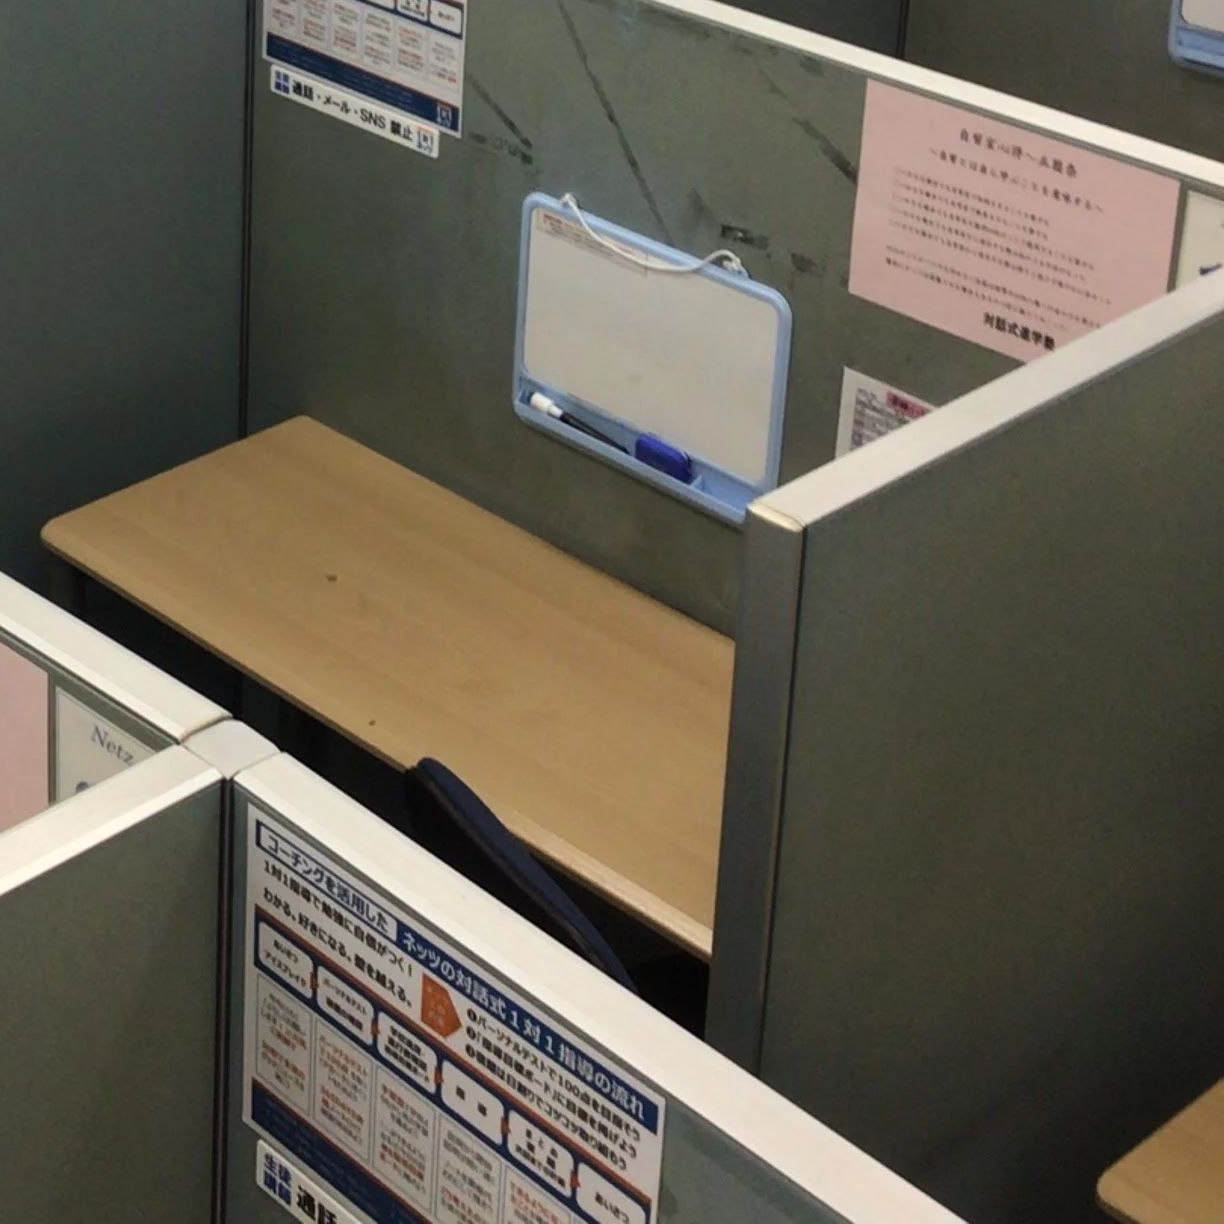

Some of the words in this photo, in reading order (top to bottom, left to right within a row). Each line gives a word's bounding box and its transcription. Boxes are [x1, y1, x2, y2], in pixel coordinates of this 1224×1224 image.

[90, 725, 135, 768] Netz
[267, 833, 389, 935] コーチングを活用した
